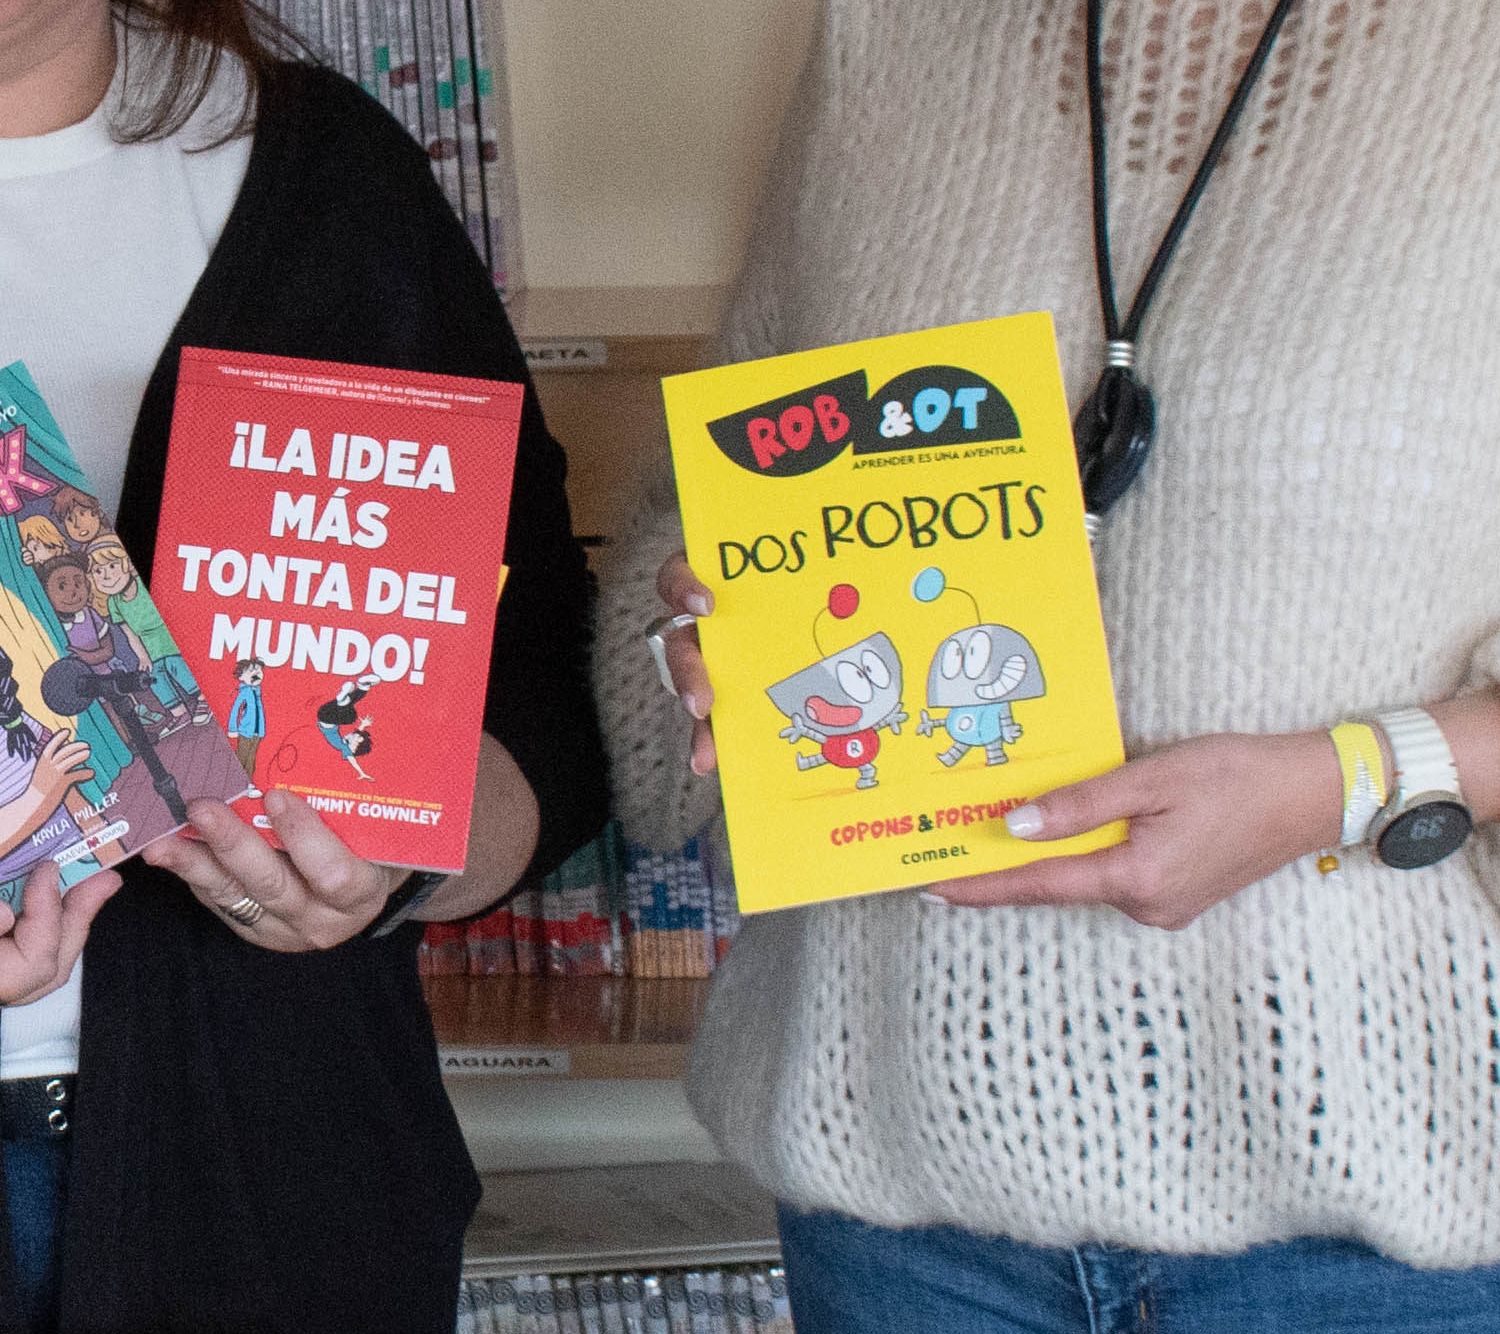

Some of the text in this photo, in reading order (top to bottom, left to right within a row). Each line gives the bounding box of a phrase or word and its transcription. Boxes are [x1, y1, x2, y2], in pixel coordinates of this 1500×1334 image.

[229, 422, 456, 494] ¡LA IDEA
[745, 394, 851, 469] ROB
[851, 444, 1026, 470] APRENDER ES UNA AVENTURA
[269, 487, 391, 550] MÁS
[717, 480, 1048, 581] DOS ROBOTS
[177, 543, 468, 625] TONTA DEL
[209, 613, 430, 686] MUNDO!
[31, 820, 71, 848] KAYLA
[73, 791, 121, 823] MILLER
[357, 802, 442, 826] GOWNLEY
[829, 814, 915, 847] COPONS
